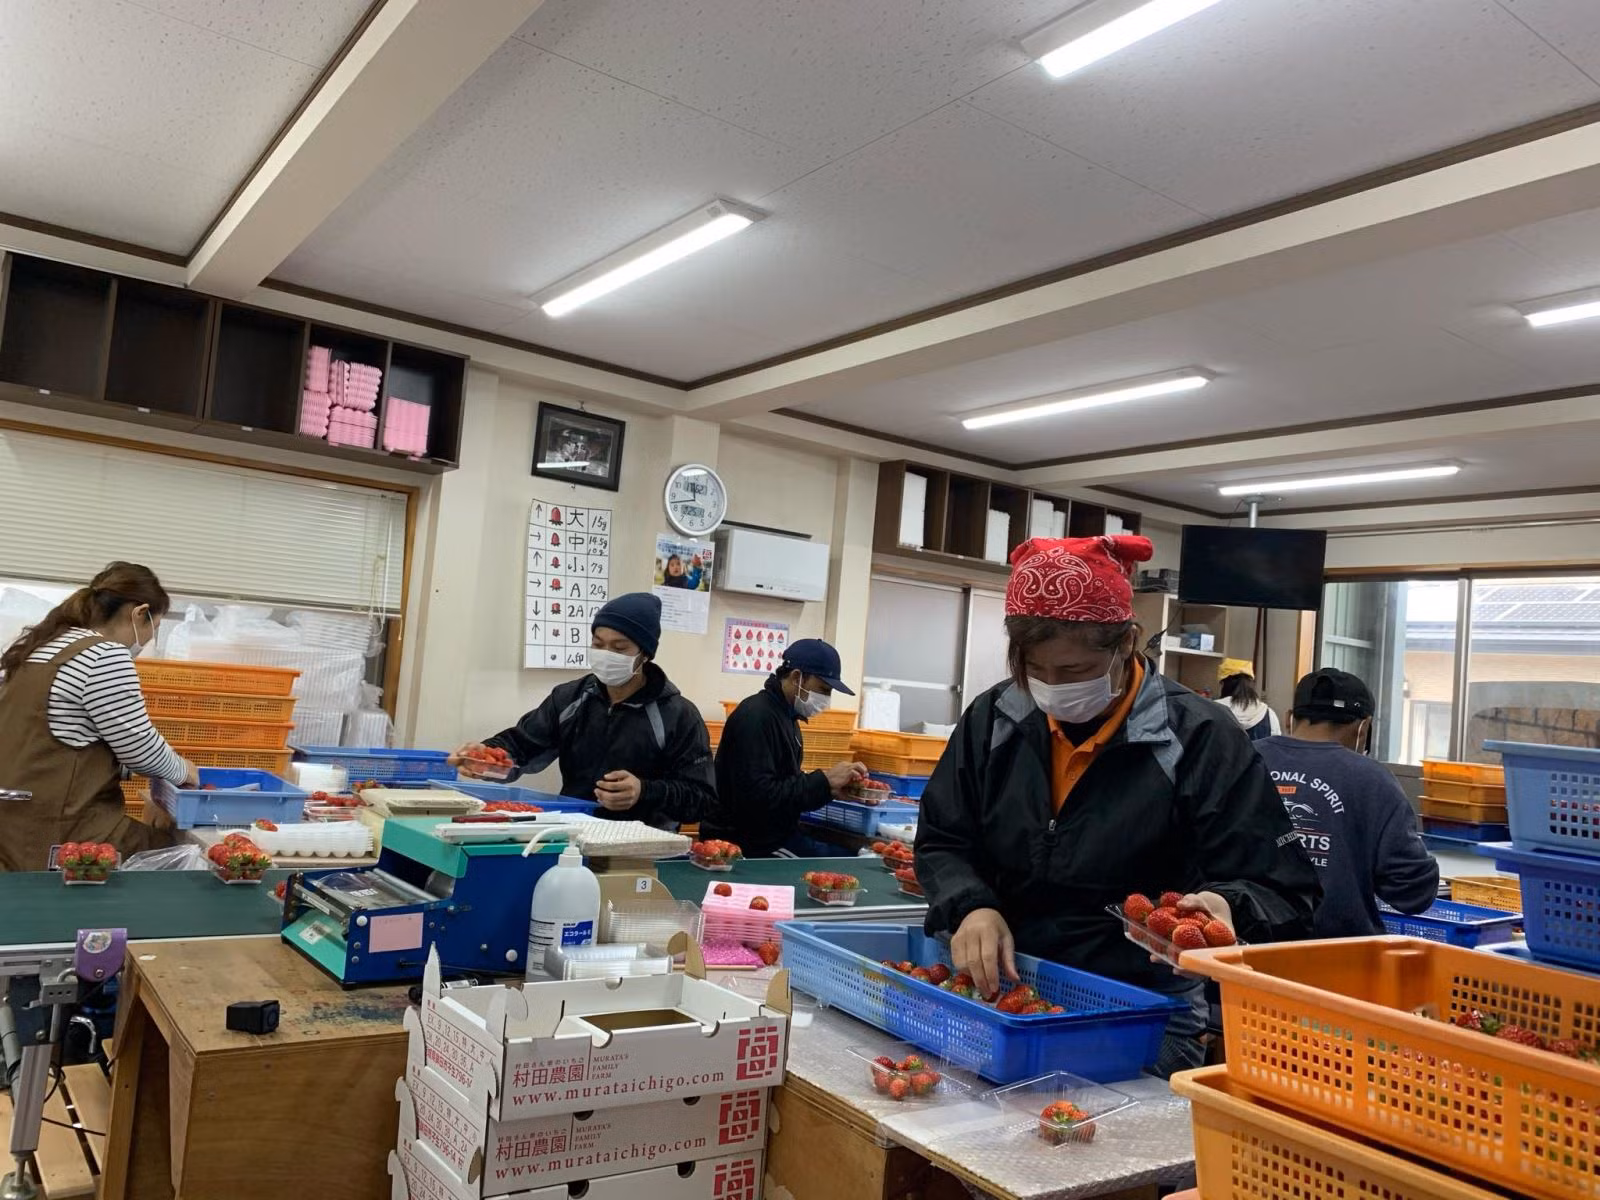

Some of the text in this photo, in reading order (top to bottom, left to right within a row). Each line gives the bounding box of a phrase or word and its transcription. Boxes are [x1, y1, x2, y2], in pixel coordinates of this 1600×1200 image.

[675, 481, 682, 489] 10
[567, 509, 607, 531] 大 15g
[568, 533, 585, 551] 中
[568, 557, 585, 573] 小
[570, 583, 581, 598] A
[568, 605, 584, 618] 2A
[570, 628, 580, 644] B
[1270, 770, 1345, 814] ONAL SPIRIT
[641, 881, 647, 890] 3
[592, 1063, 619, 1071] FAMILY
[512, 1064, 585, 1089] 村田農園
[512, 1071, 725, 1106] www.murataichigo.com
[575, 1132, 602, 1142] FAMILY
[496, 1135, 567, 1162] 村田農園
[496, 1137, 706, 1179] www.murataichigo.com
